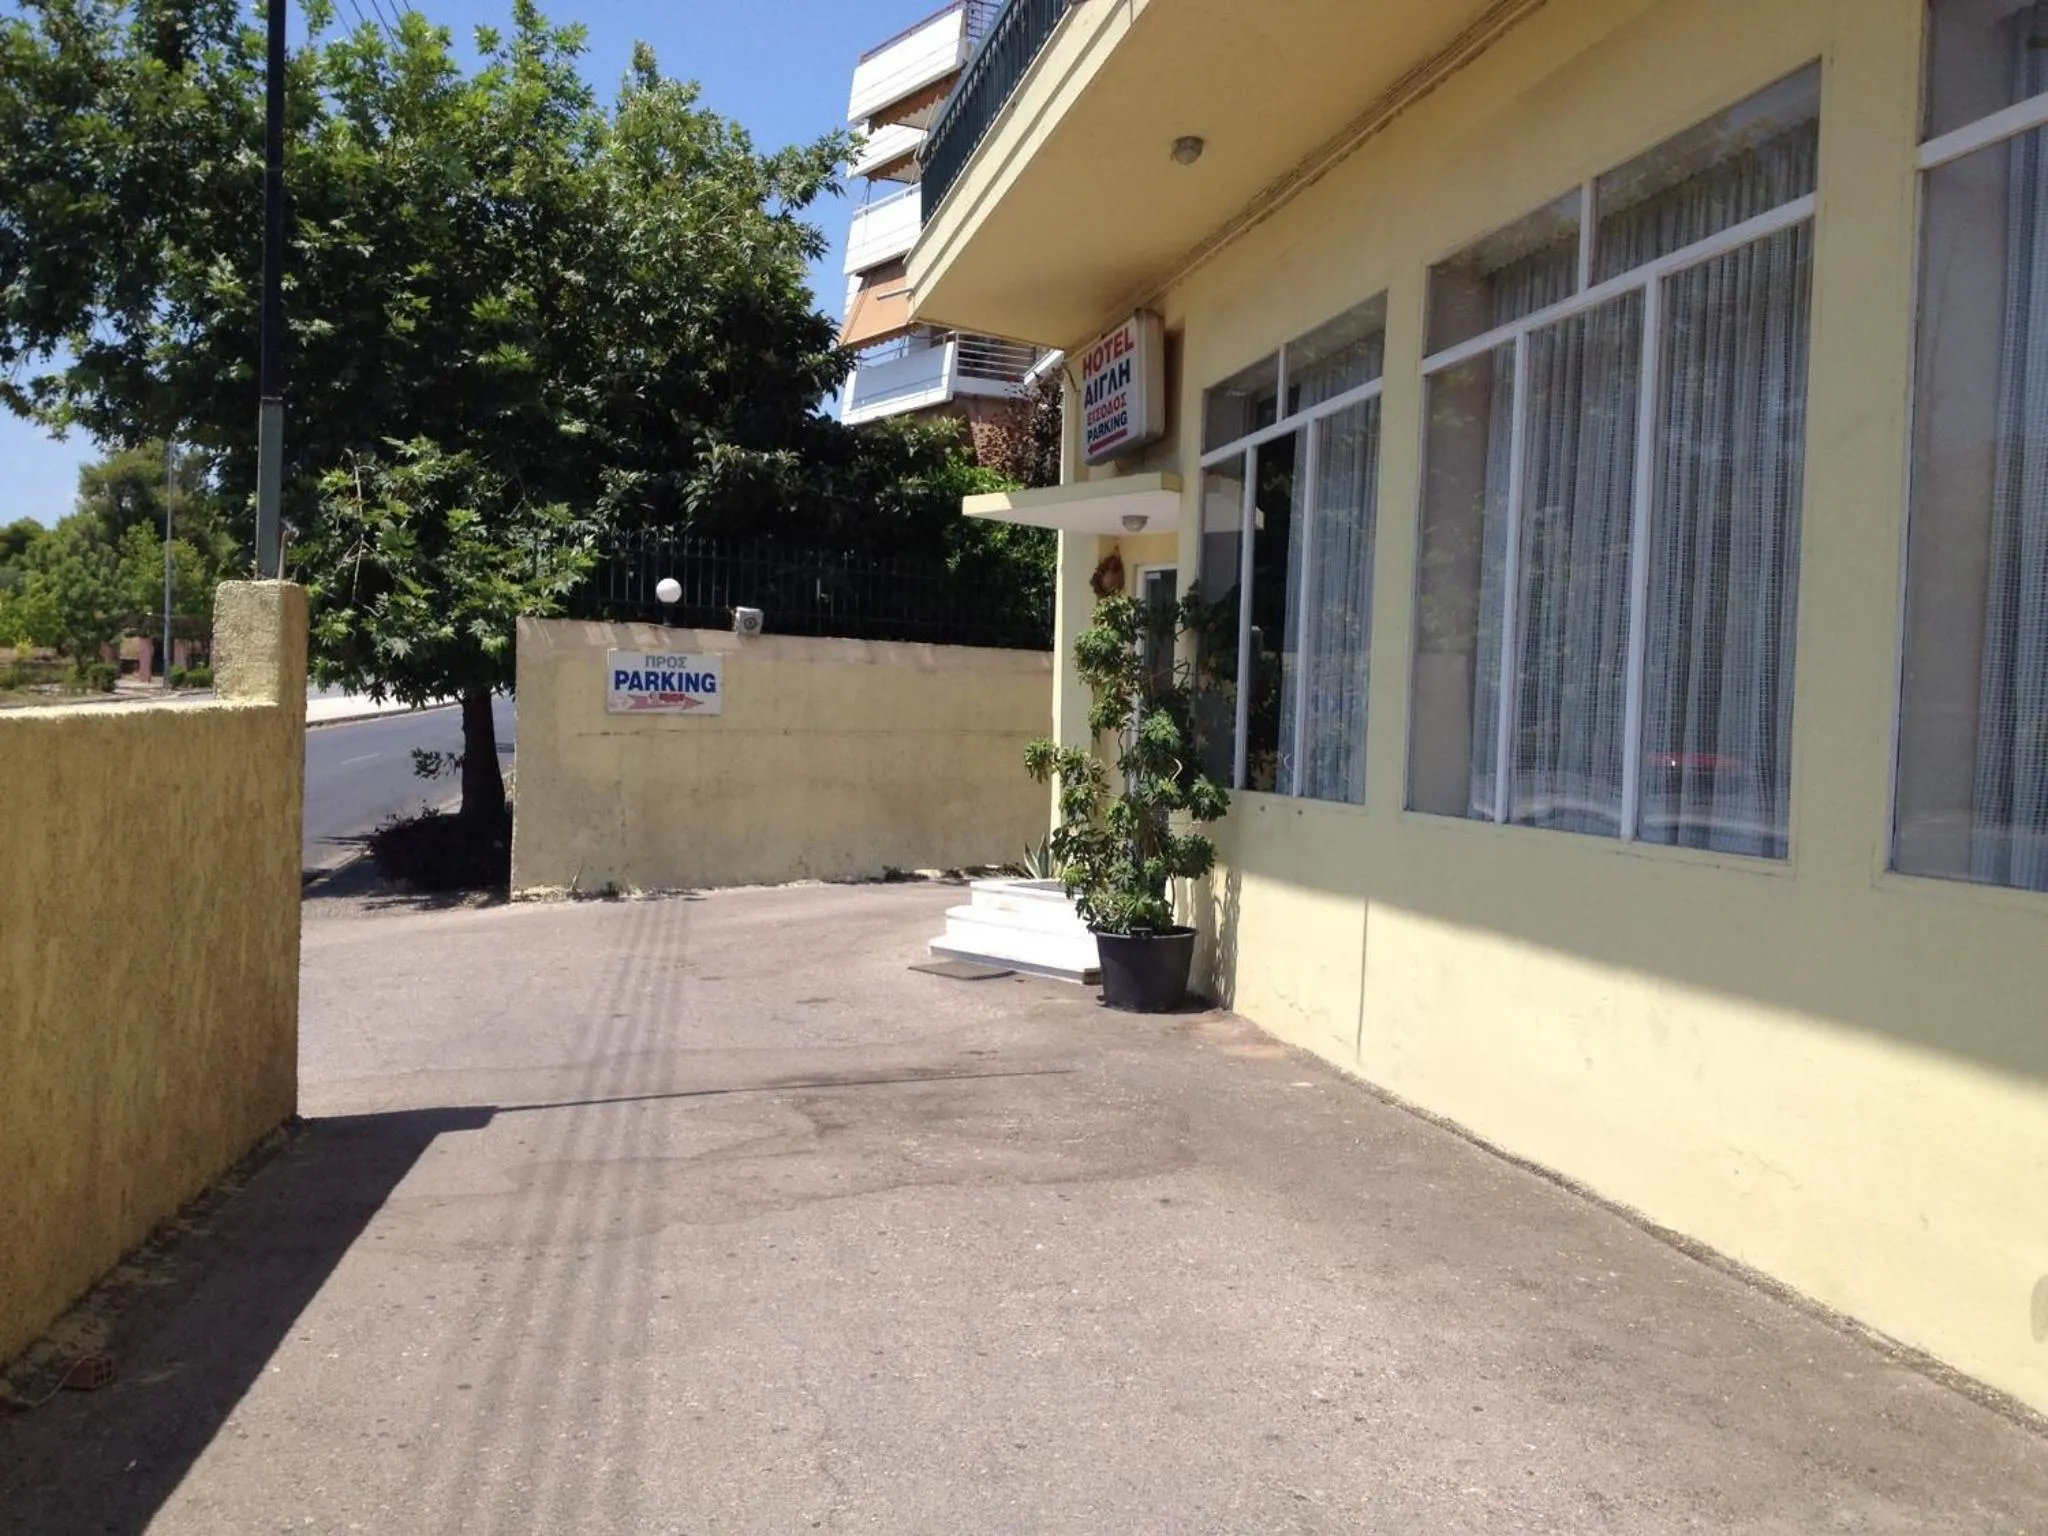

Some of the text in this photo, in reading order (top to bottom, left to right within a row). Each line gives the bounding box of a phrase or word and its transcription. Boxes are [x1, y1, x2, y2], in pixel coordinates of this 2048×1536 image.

[1082, 327, 1134, 381] HOTEL
[1084, 358, 1131, 409] ΑΙΓΛΗ
[1087, 391, 1127, 426] ΕΙΣΟΔΟΣ
[1087, 410, 1128, 443] PARKING
[645, 655, 687, 669] ΠΡΟΣ
[614, 670, 717, 693] PARKING
